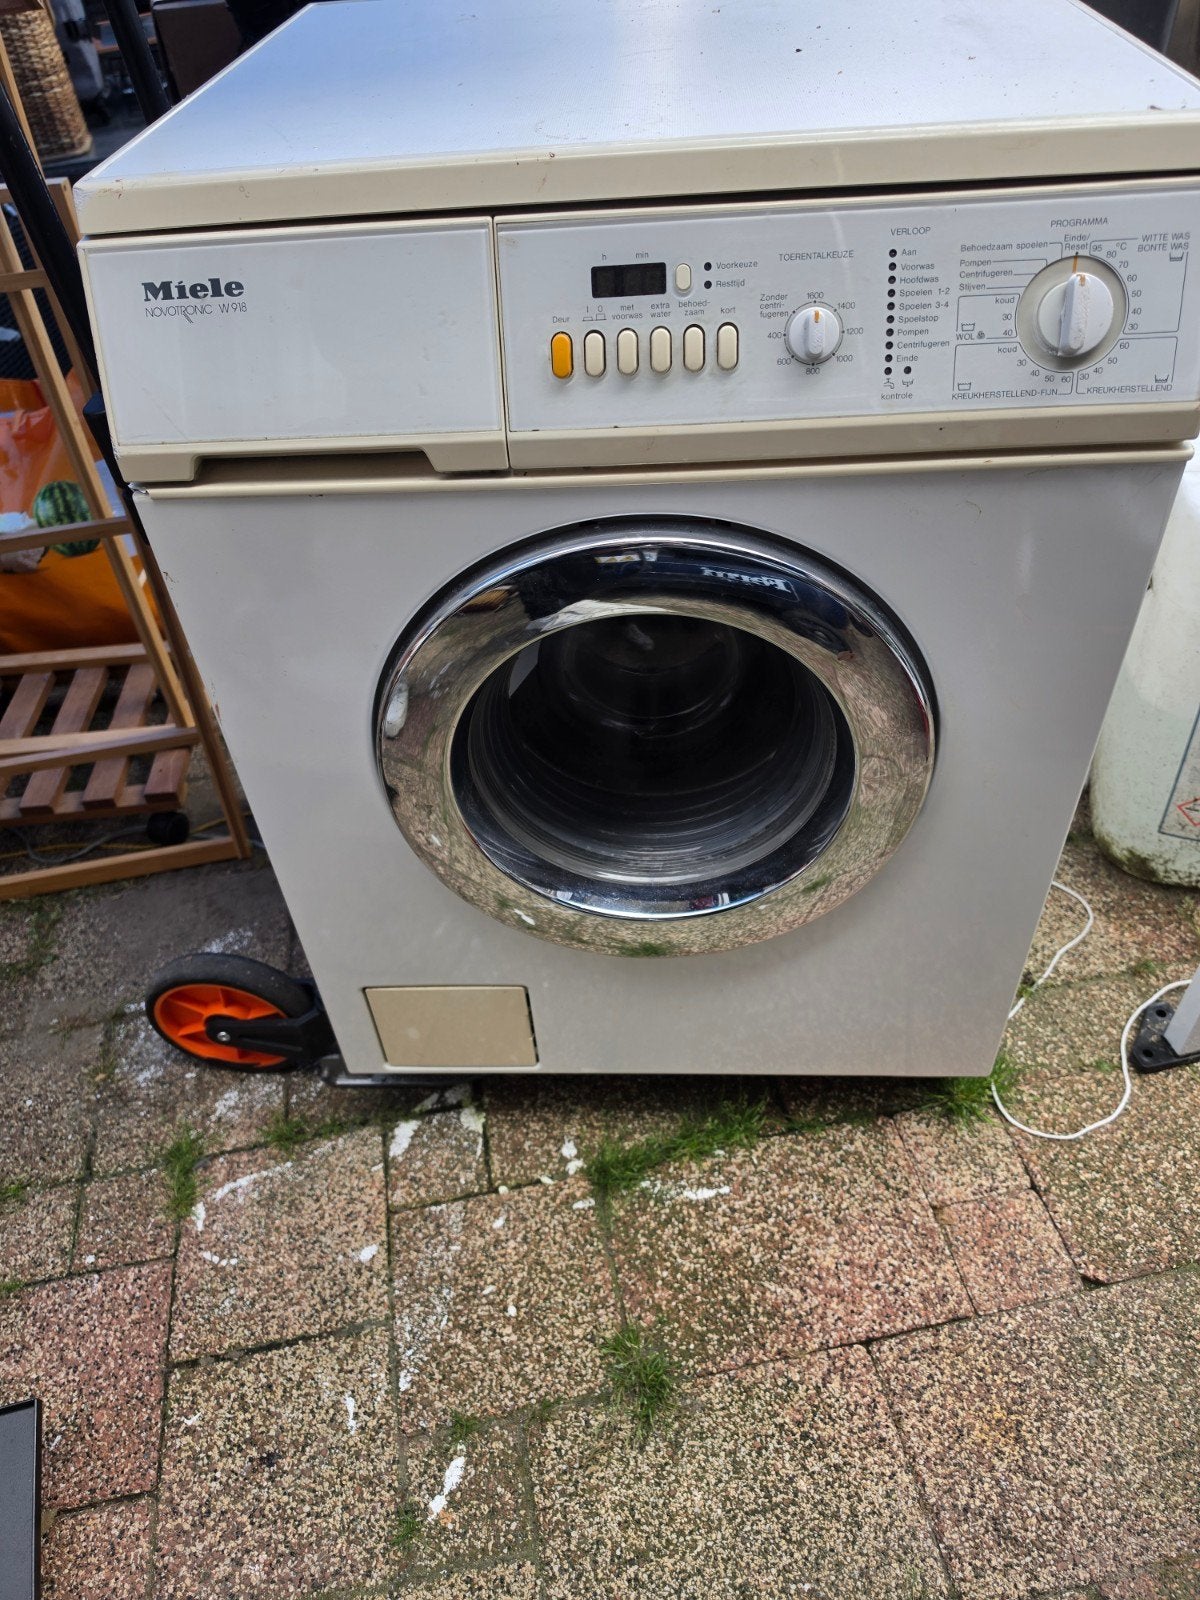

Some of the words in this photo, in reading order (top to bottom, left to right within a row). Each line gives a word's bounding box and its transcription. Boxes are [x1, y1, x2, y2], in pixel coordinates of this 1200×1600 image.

[1050, 217, 1109, 228] PROGRAMMA
[890, 226, 931, 236] VERLOOP
[1064, 234, 1090, 242] Einde/
[1142, 233, 1168, 242] WITTE
[1172, 232, 1190, 240] WAS
[960, 243, 1013, 252] Behoedzaam
[1016, 241, 1048, 250] spoelen
[1064, 243, 1088, 251] Reset
[1092, 244, 1102, 252] 95
[1138, 243, 1170, 252] BONTE
[1171, 242, 1189, 250] WAS
[602, 253, 607, 261] h
[635, 251, 649, 259] min
[779, 250, 854, 261] TOERENTALKEUZE
[1106, 250, 1117, 258] 80
[716, 260, 758, 270] Voorkeuze
[901, 263, 935, 271] Voorwas
[960, 259, 992, 267] Pompen
[960, 269, 1013, 279] Centrifugeren
[1127, 274, 1137, 282] 60
[900, 275, 939, 284] Hoofdwas
[716, 280, 745, 289] Resttijd
[959, 283, 985, 292] Stijven
[142, 278, 244, 301] Miele
[900, 288, 933, 298] Spoelen
[938, 287, 950, 295] 1-2
[760, 293, 788, 301] Zonder
[995, 296, 1015, 304] koud
[650, 302, 670, 310] extra
[678, 300, 710, 308] behoed-
[899, 302, 932, 311] Spoelen
[145, 304, 213, 323] NOVOTRONIC
[760, 310, 789, 319] fugeren
[1131, 307, 1142, 315] 40
[898, 315, 939, 324] Spoelstop
[897, 328, 929, 336] Pompen
[956, 333, 975, 341] WOL
[897, 340, 950, 350] Centrifugeren
[997, 345, 1017, 353] koud
[896, 354, 919, 362] Einde
[1031, 369, 1040, 377] 40
[1086, 384, 1172, 394] KREUKHERSTELLEND
[881, 392, 913, 400] kontrole
